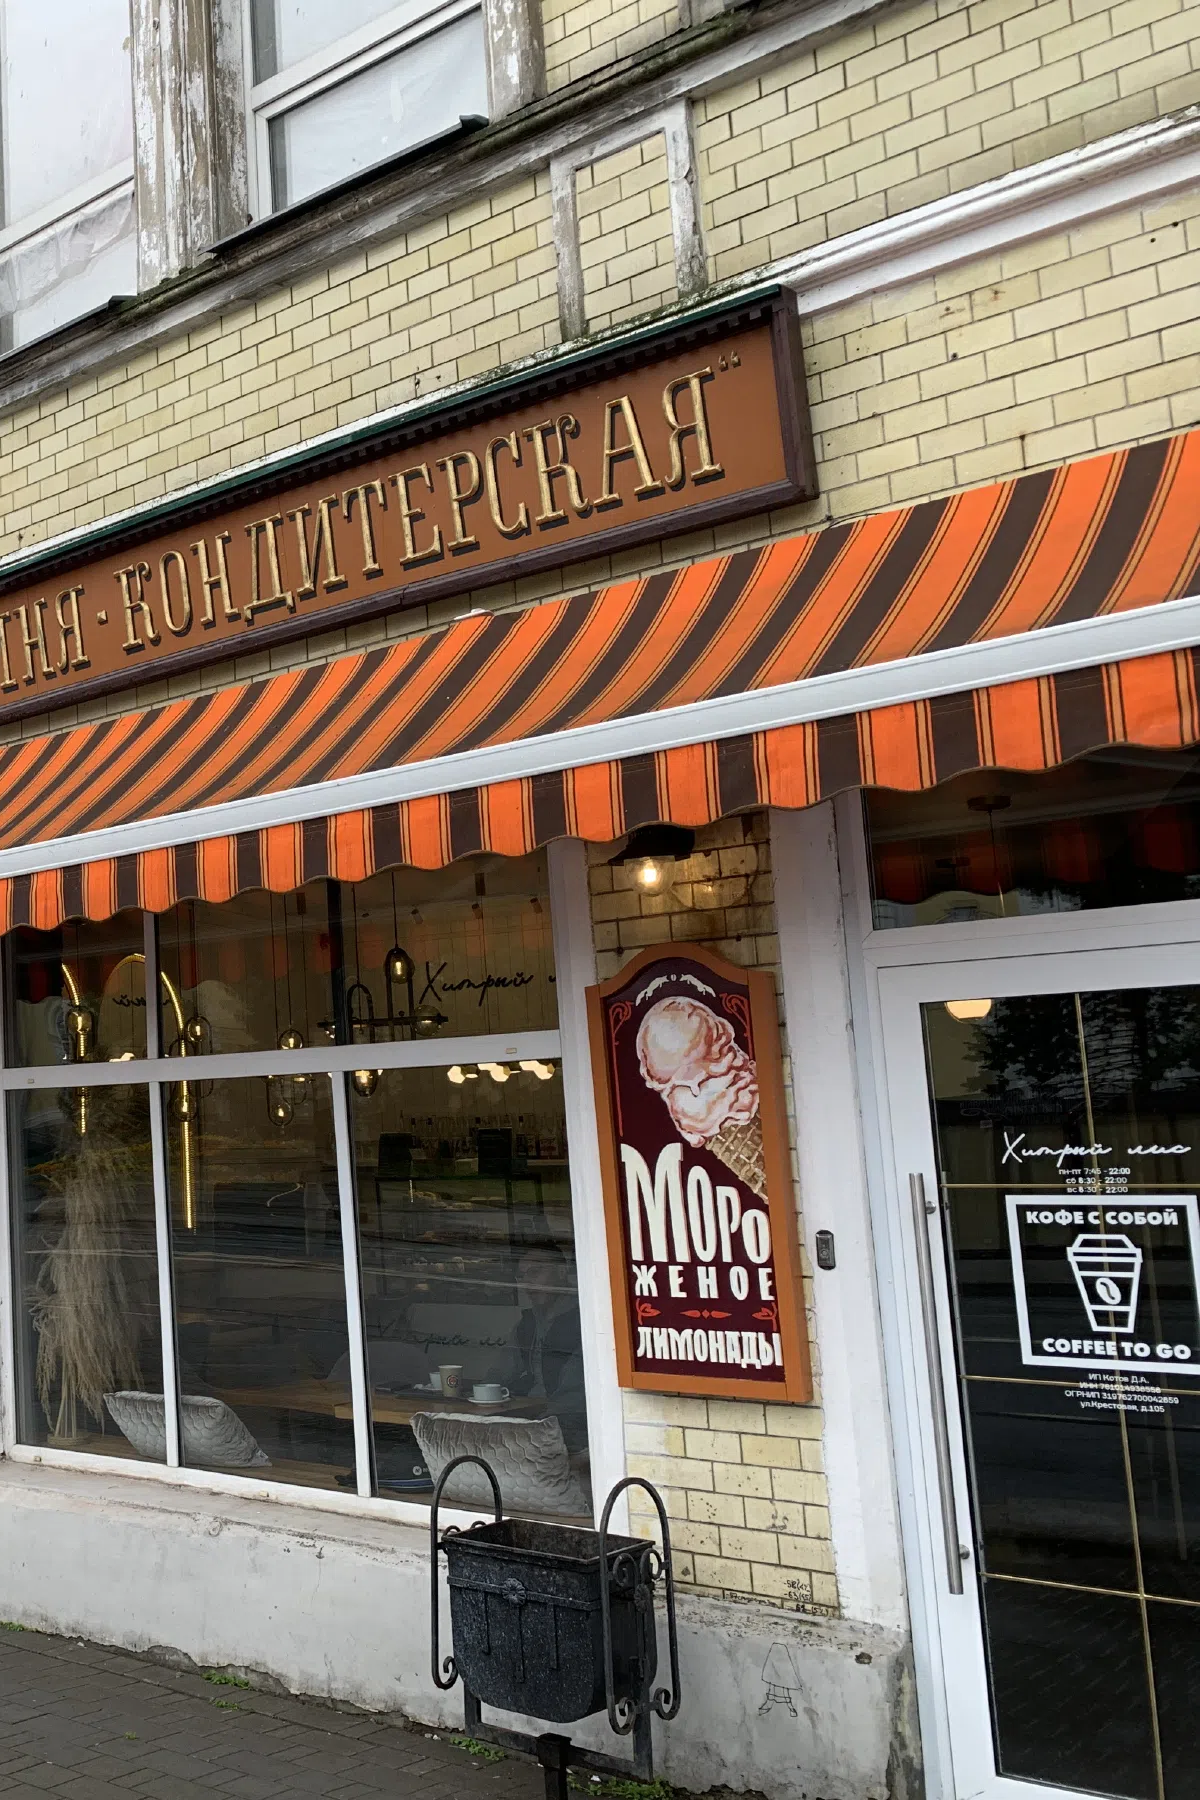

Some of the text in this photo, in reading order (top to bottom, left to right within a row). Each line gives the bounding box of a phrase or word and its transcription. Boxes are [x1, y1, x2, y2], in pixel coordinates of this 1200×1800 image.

[418, 960, 534, 1007] Хитрый
[1001, 1131, 1193, 1168] Хитрый лис
[1084, 1167, 1102, 1175] 7:45
[1108, 1167, 1131, 1175] 22:00
[1104, 1176, 1128, 1184] 22:00
[1105, 1186, 1129, 1194] 22:00
[1026, 1208, 1179, 1226] КОФЕ С СОБОЙ
[631, 1264, 776, 1301] ЖЕНОЕ
[636, 1325, 784, 1369] ЛИМОНАДЫ
[1042, 1338, 1192, 1360] COFFEE TO GO
[1088, 1373, 1102, 1381] ИП
[1103, 1374, 1129, 1382] Котов
[1064, 1389, 1100, 1398] ОГРНИП
